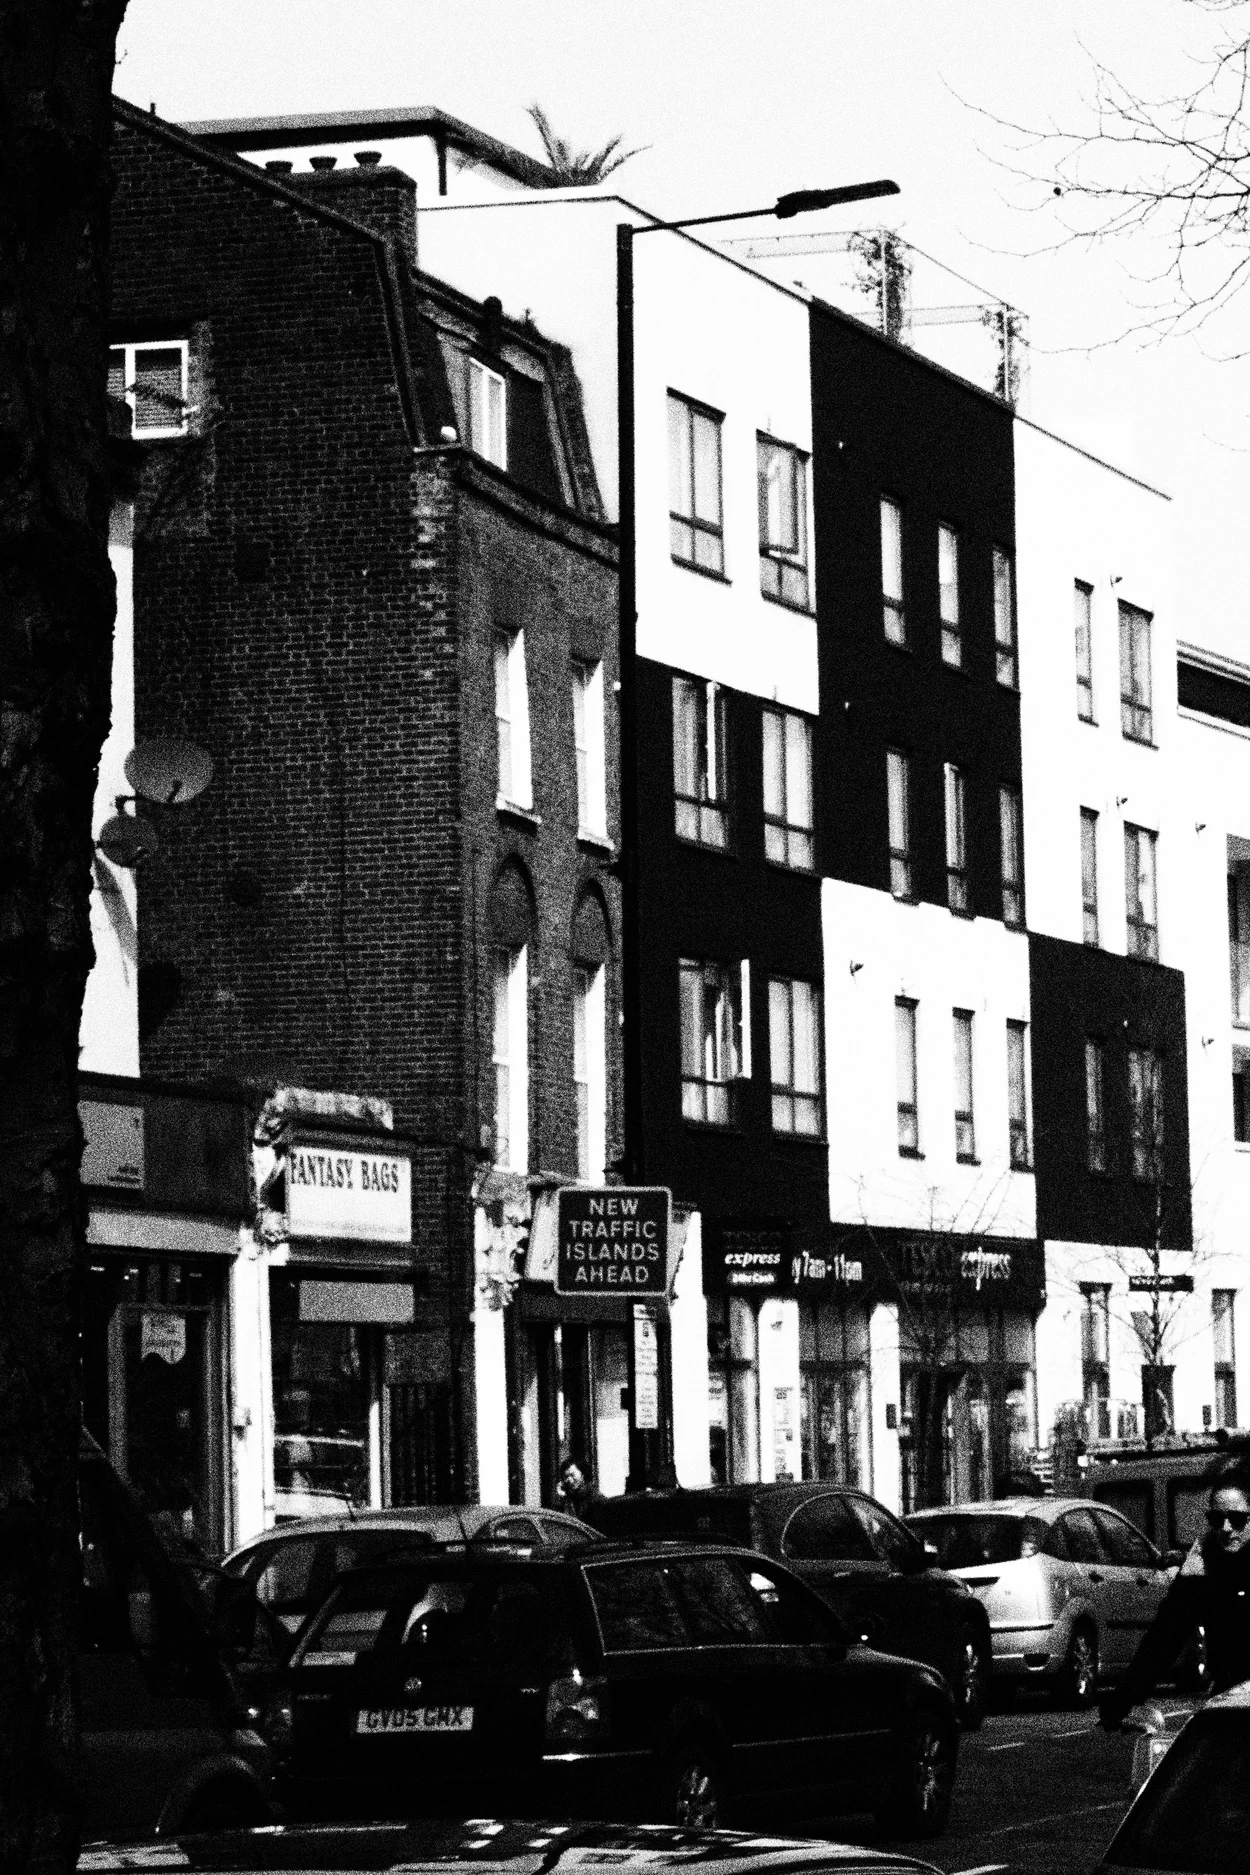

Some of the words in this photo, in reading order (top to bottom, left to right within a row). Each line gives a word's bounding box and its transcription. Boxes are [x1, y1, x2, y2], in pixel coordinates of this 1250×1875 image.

[290, 1153, 353, 1190] FANTASY
[361, 1160, 398, 1193] BAGS
[589, 1198, 639, 1216] NEW
[569, 1220, 657, 1239] TRAFFIC
[566, 1242, 660, 1261] ISLANDS
[724, 1252, 781, 1268] express
[575, 1265, 649, 1283] AHEAD
